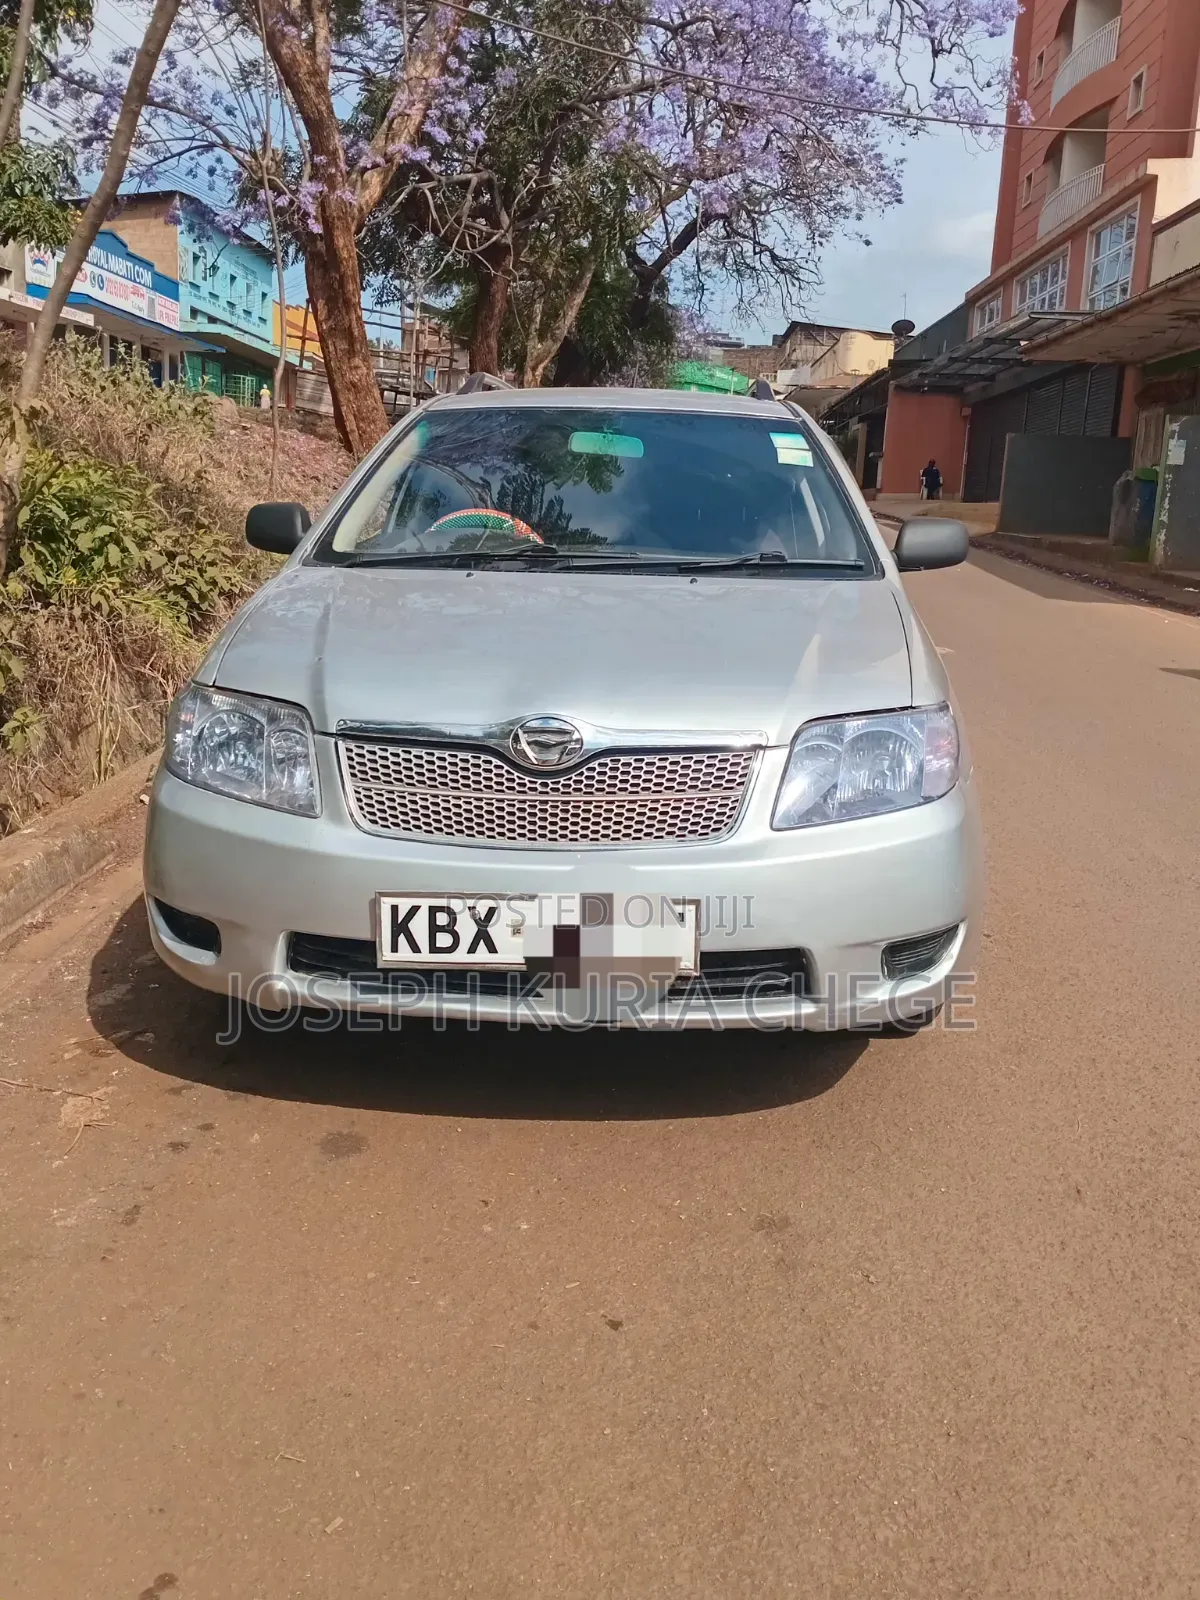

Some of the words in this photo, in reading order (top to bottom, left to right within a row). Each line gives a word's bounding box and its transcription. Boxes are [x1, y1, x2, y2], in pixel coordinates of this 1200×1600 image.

[108, 253, 134, 281] MABATI
[134, 265, 152, 288] COM
[390, 904, 499, 954] KBX
